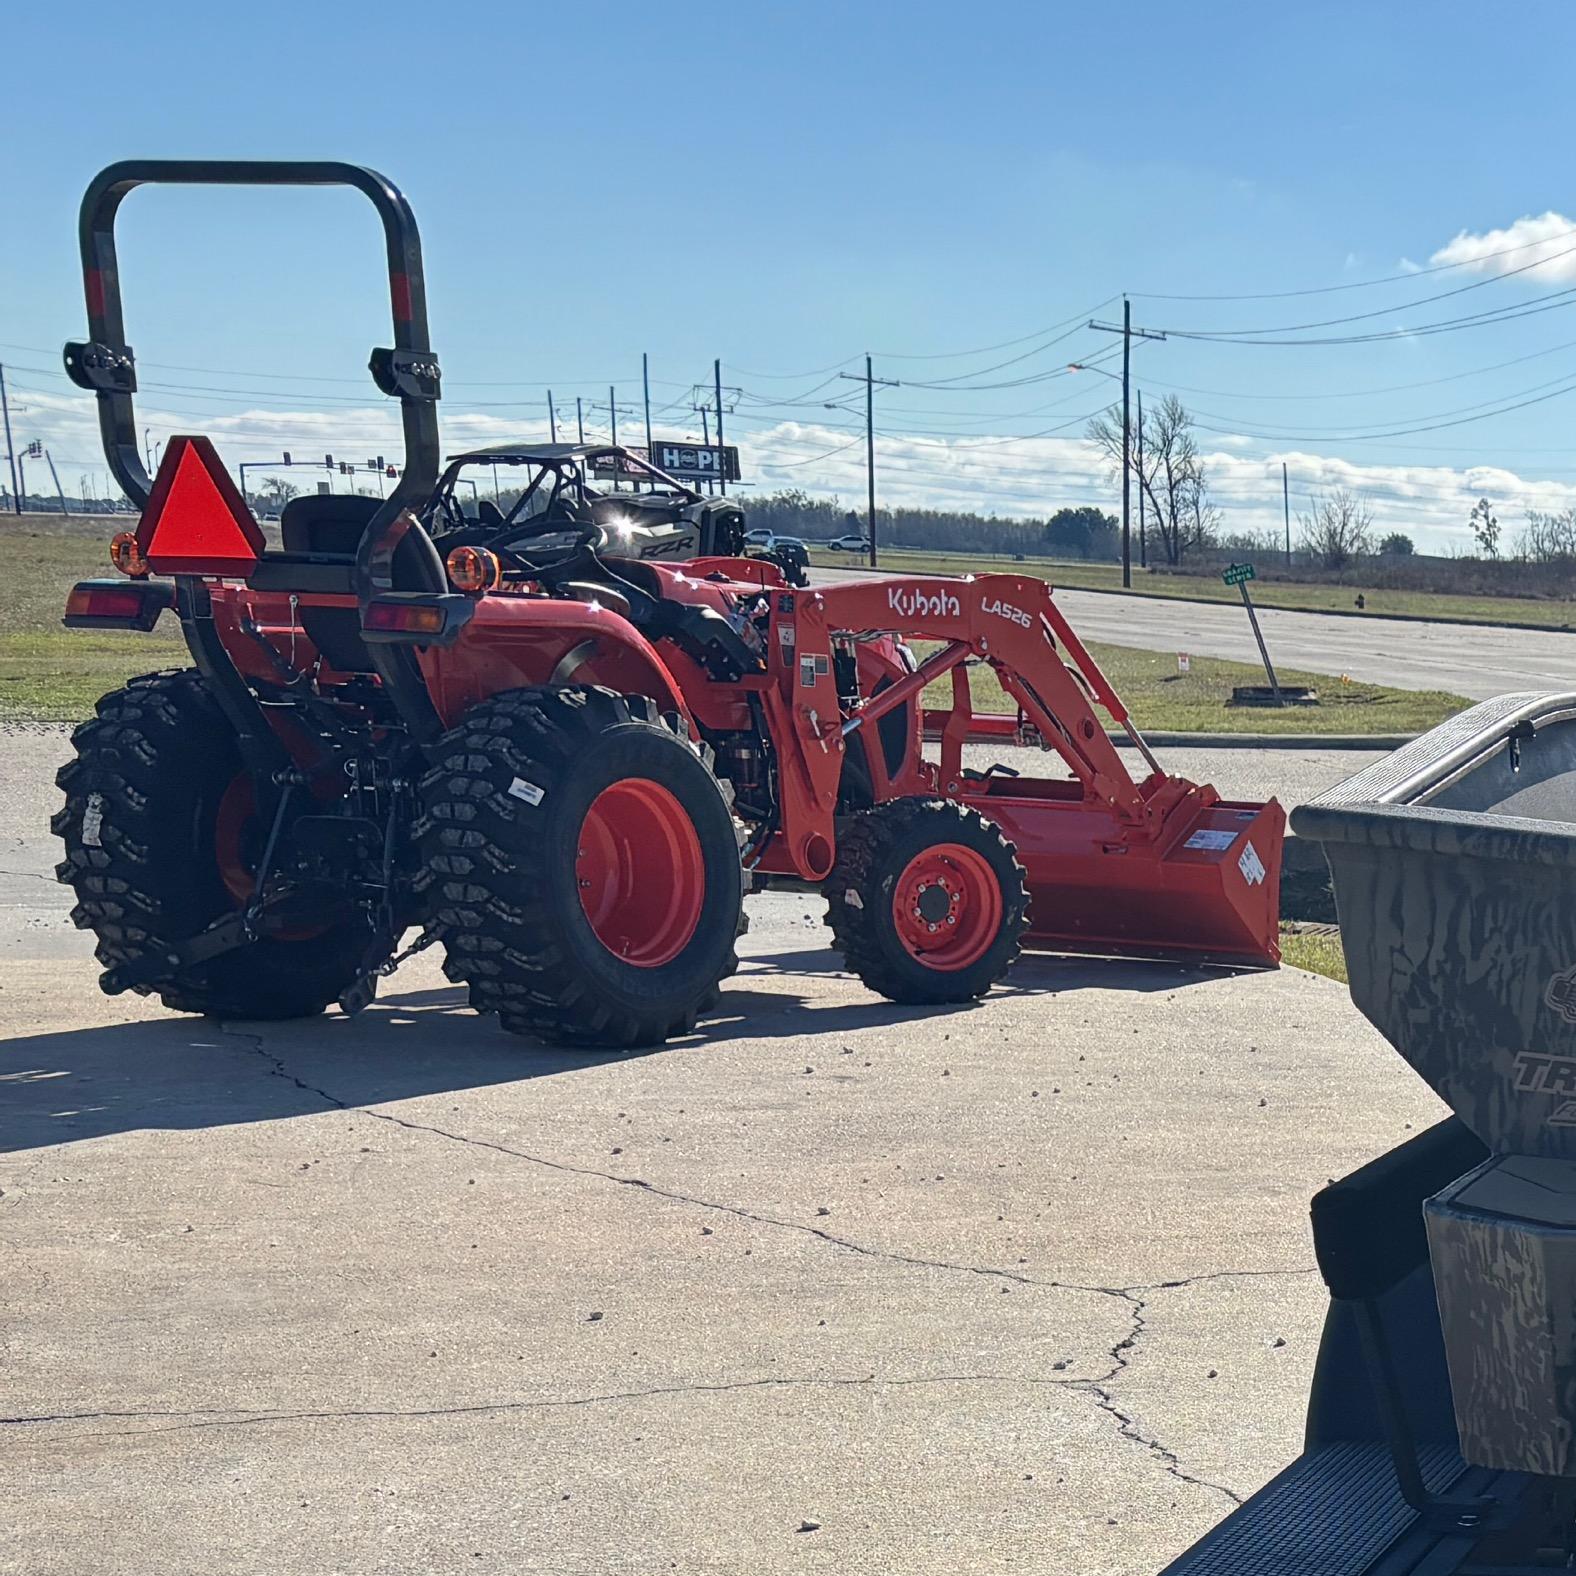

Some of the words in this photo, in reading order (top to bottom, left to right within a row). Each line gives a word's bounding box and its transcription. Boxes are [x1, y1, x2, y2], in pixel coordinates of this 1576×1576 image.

[638, 536, 695, 560] RZR
[888, 587, 960, 617] Kubota
[981, 596, 1033, 629] LA526
